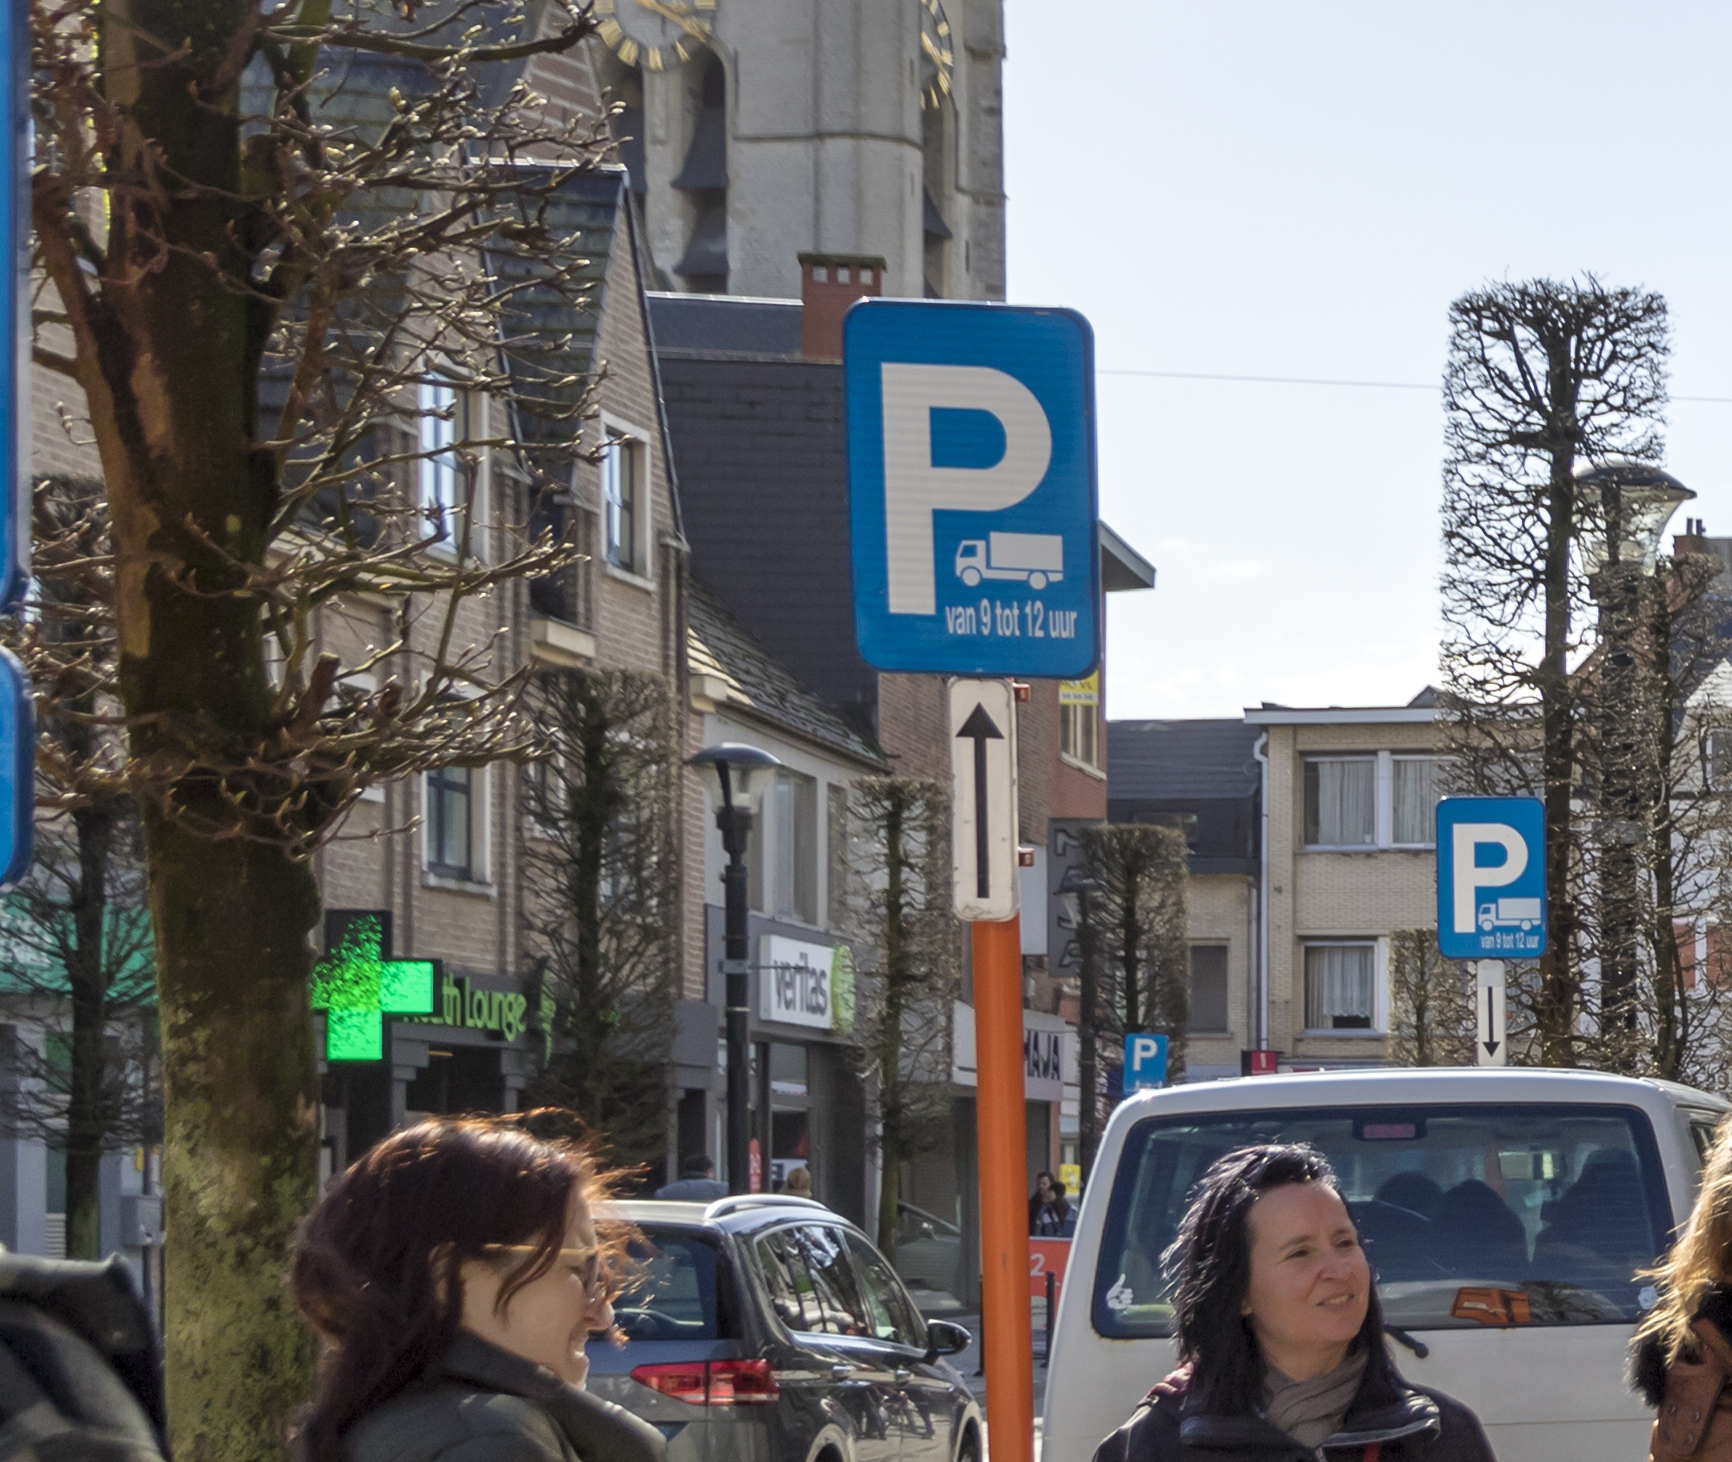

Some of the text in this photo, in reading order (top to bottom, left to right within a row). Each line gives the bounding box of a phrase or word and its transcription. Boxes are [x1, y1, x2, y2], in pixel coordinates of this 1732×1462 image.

[881, 362, 1053, 616] P
[945, 597, 1078, 639] van 9 tot 12 uur
[1452, 822, 1529, 933] P
[1480, 931, 1540, 949] van 9 tot 12 uur
[463, 976, 528, 1043] Lounge
[774, 951, 828, 1017] veritas
[1133, 1038, 1159, 1071] P
